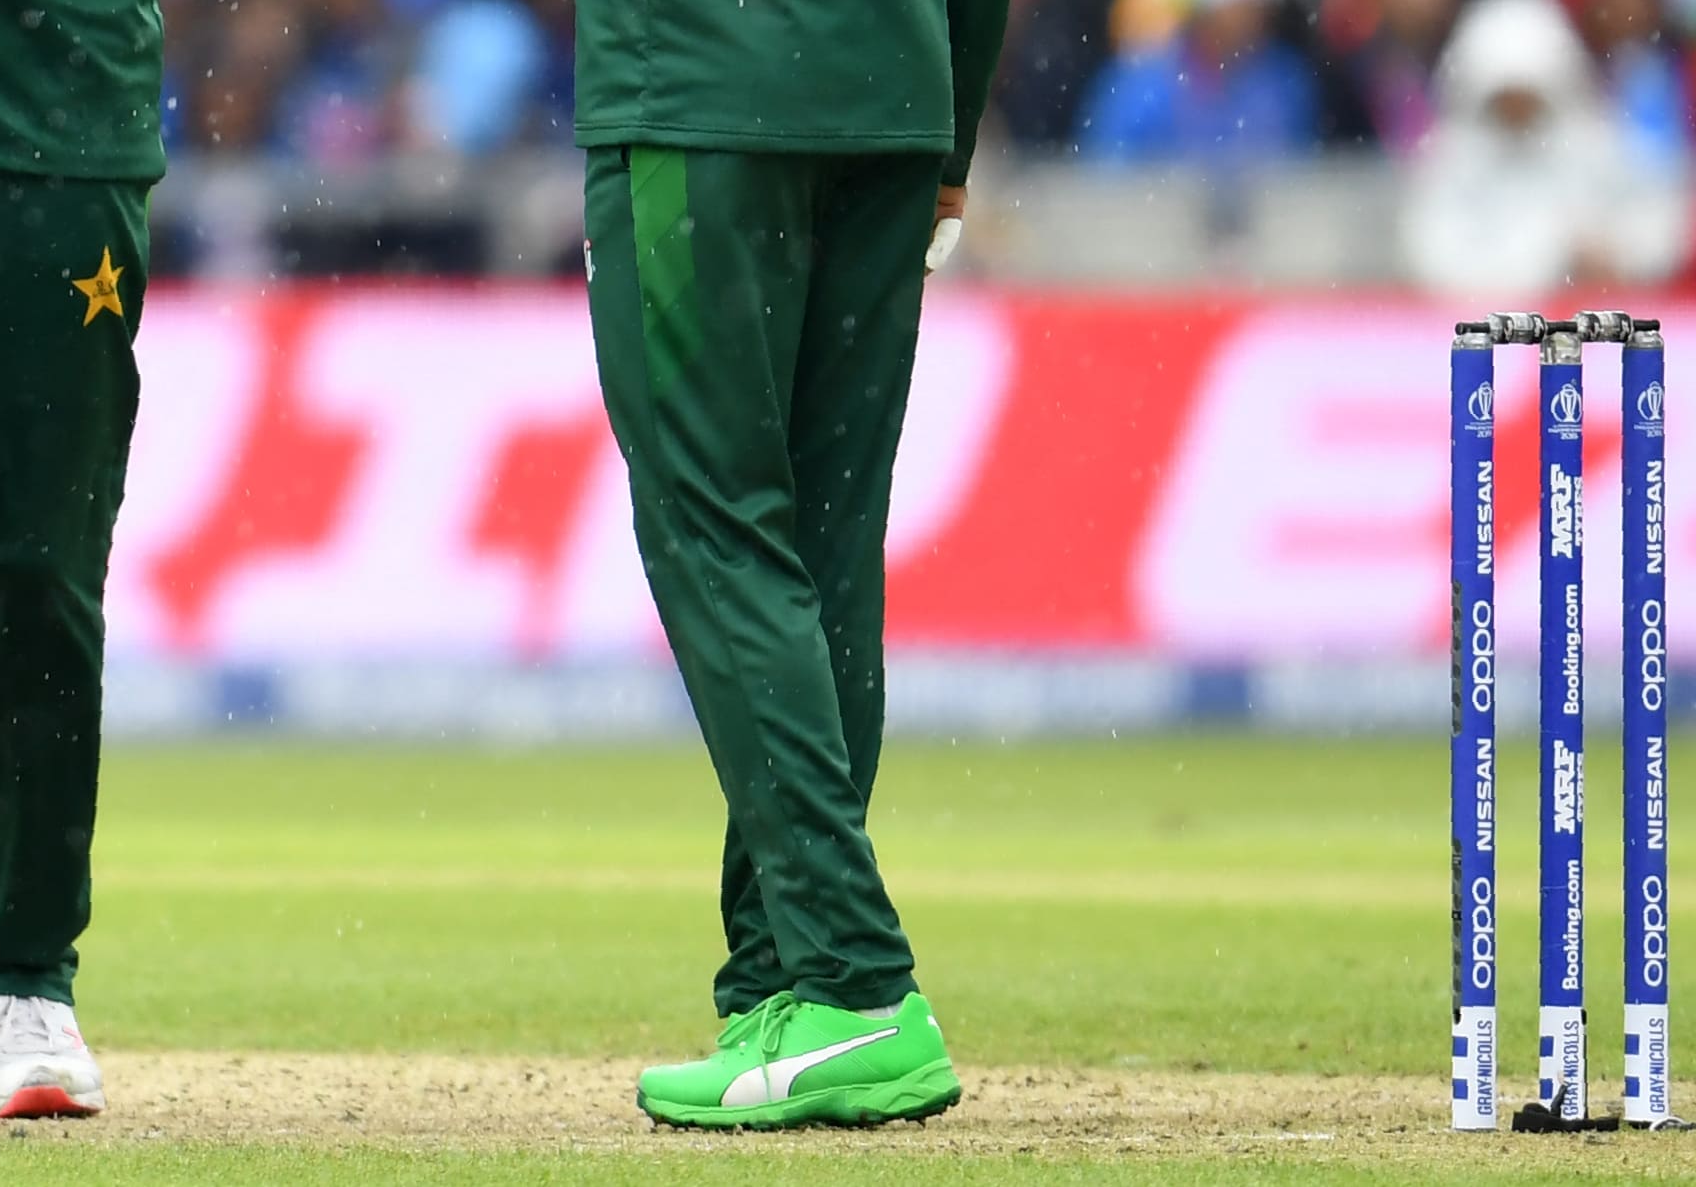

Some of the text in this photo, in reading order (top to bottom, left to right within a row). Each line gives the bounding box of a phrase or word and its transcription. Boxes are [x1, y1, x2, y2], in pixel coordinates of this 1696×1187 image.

[1477, 461, 1493, 575] NISSAN
[1550, 463, 1574, 559] MRF
[1646, 461, 1662, 574] NISSAN
[1472, 600, 1494, 712] oppo
[1563, 583, 1581, 715] Booking.com
[1642, 599, 1665, 711] oppo
[1476, 738, 1492, 851] NISSAN
[1554, 740, 1575, 834] MRF
[1647, 736, 1662, 849] NISSAN
[1472, 877, 1494, 990] oppo
[1562, 859, 1582, 990] Booking.com
[1643, 875, 1666, 988] oppo
